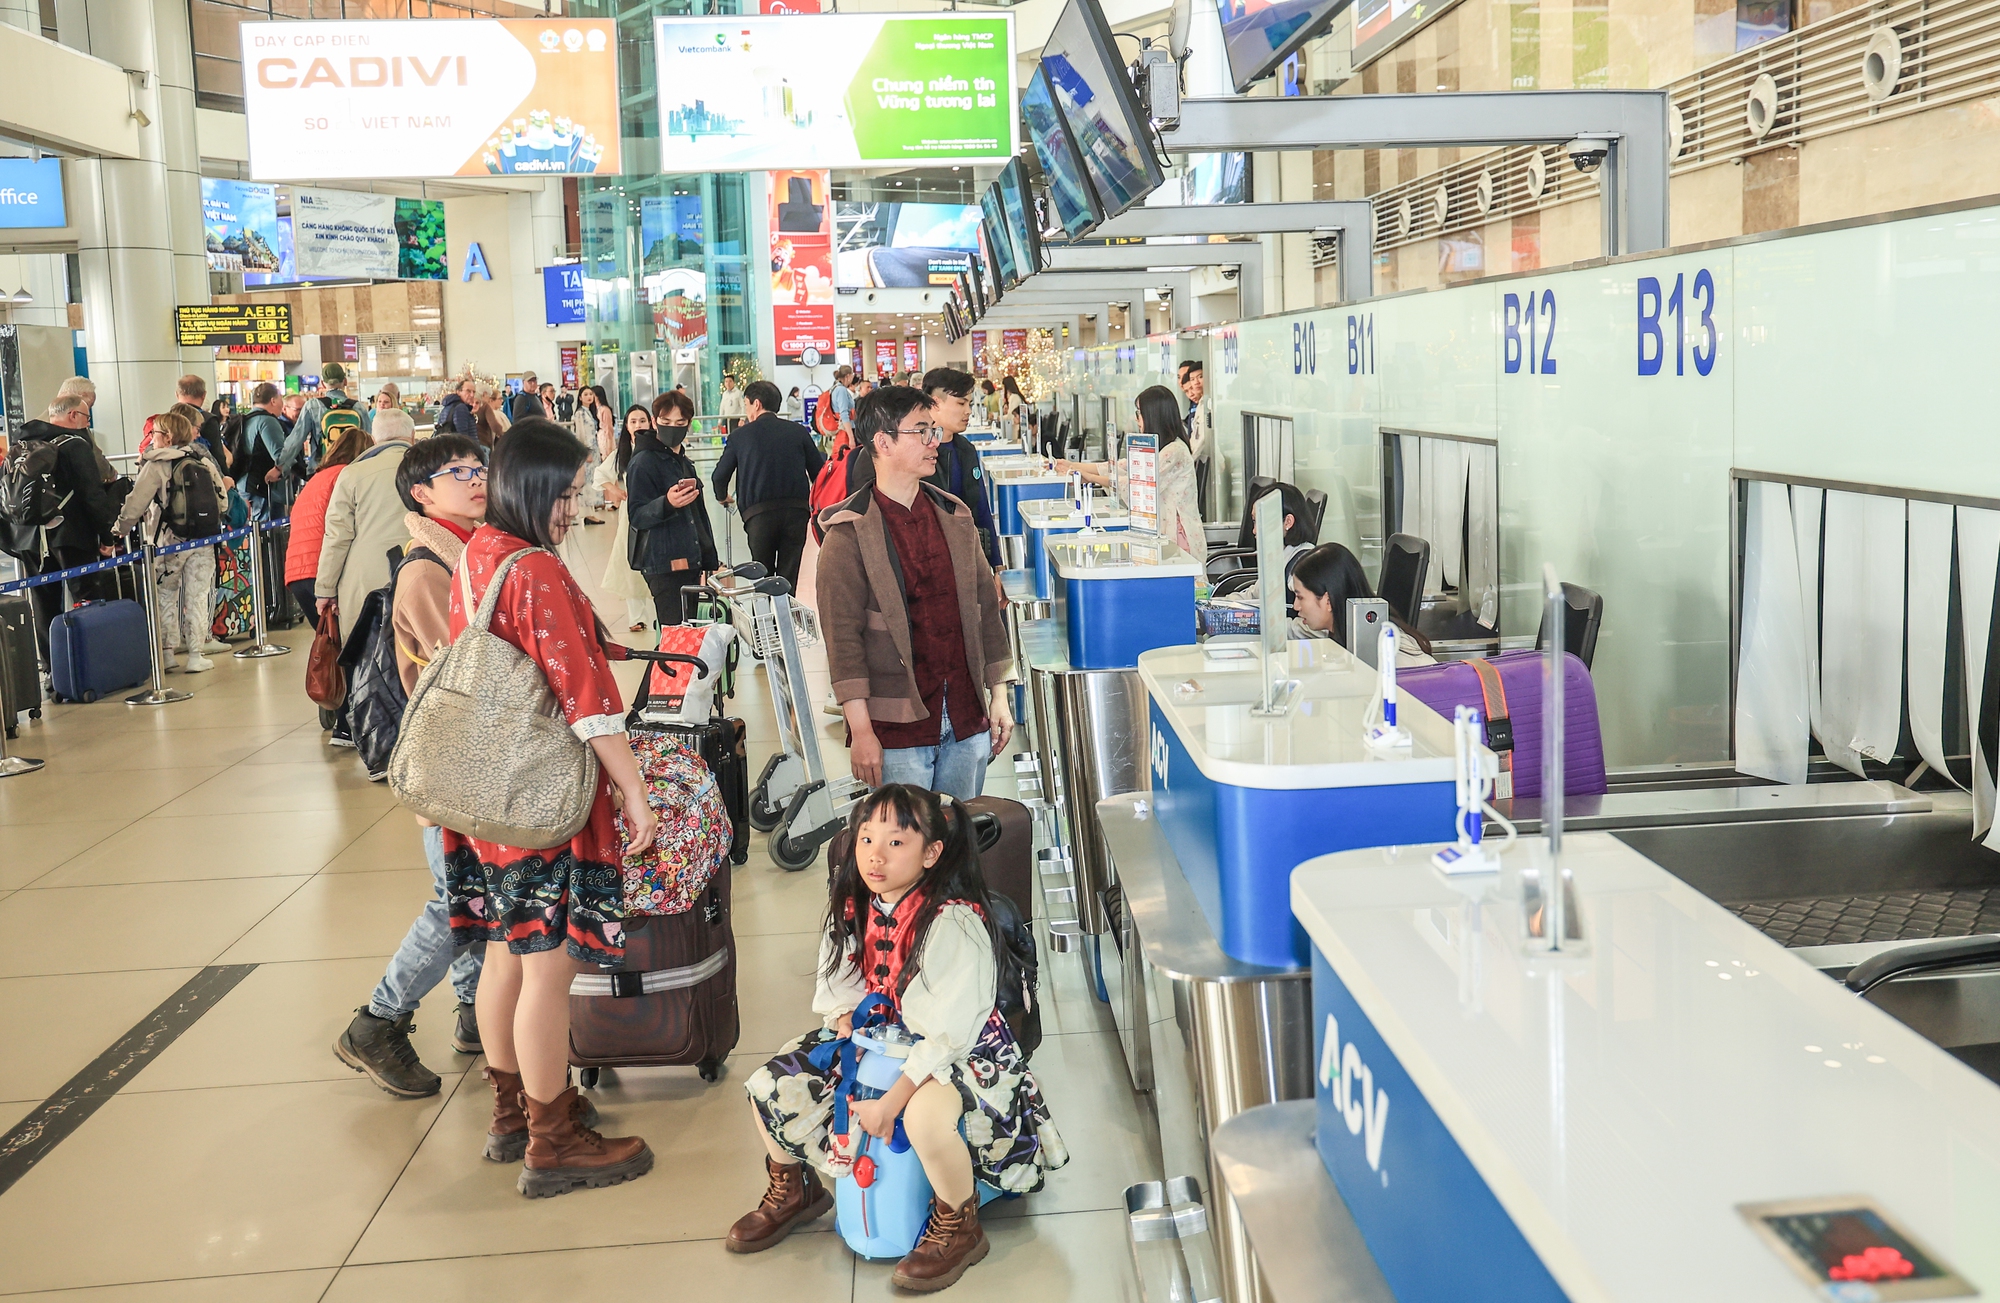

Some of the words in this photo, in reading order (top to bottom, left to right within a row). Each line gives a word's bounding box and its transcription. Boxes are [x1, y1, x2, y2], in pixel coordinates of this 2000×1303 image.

[257, 56, 468, 89] CADIVI
[872, 78, 924, 94] Chung
[973, 76, 996, 91] tin
[876, 94, 920, 111] Vững
[977, 93, 996, 108] lai
[408, 116, 452, 128] NAM
[514, 158, 566, 172] cadivi.vn
[0, 188, 38, 205] ffice
[300, 195, 313, 204] NIA
[462, 242, 493, 282] A
[574, 299, 584, 307] PH
[1504, 288, 1557, 374] B12
[1637, 268, 1717, 376] B13
[246, 333, 254, 343] B
[1293, 320, 1316, 375] B10
[1348, 312, 1374, 375] B11
[1224, 330, 1238, 374] B09
[1152, 721, 1169, 790] ACV
[1319, 1012, 1389, 1172] ACV
